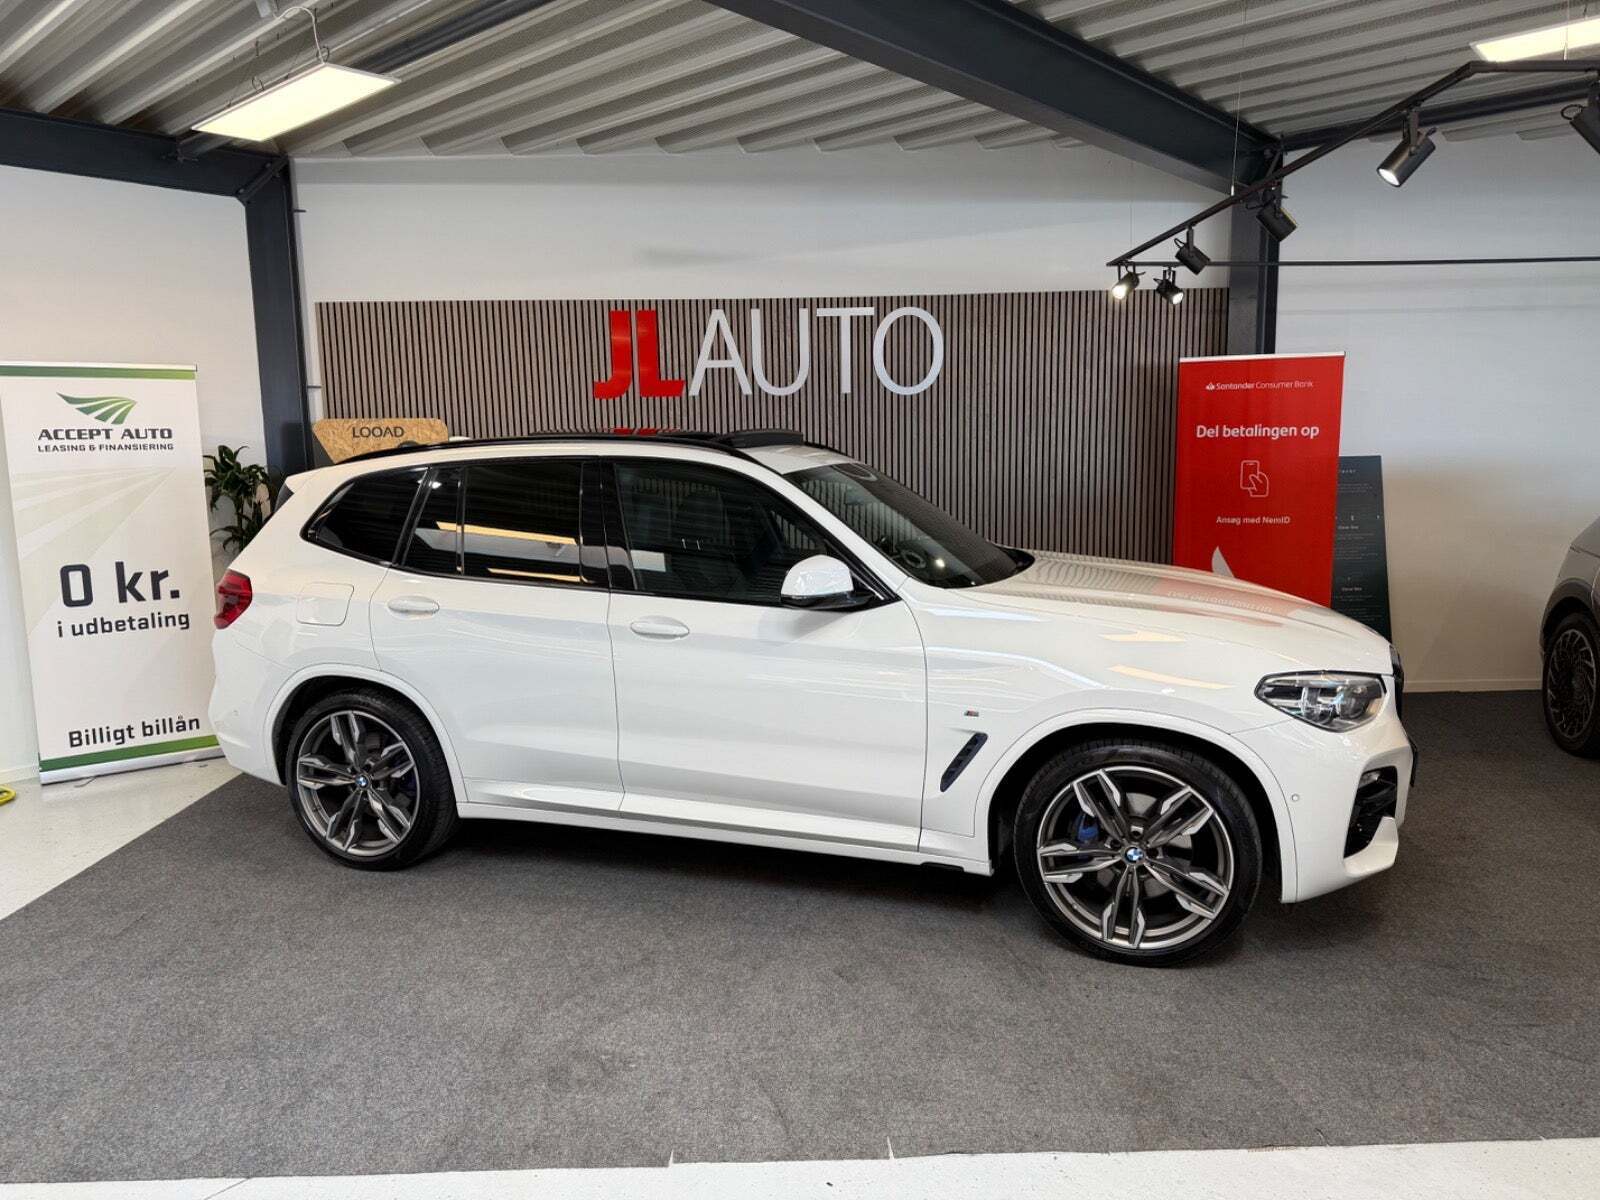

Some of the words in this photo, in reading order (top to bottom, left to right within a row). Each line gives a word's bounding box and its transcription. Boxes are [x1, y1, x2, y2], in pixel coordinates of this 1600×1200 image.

[1216, 381, 1255, 391] Santander
[1255, 380, 1293, 390] Consumer
[1294, 380, 1313, 388] Bank
[38, 428, 113, 441] ACCEPT
[121, 428, 173, 440] AUTO
[351, 426, 405, 439] LOOAD
[1196, 424, 1219, 439] Del
[1222, 423, 1298, 441] betalingen
[1300, 425, 1320, 440] op
[38, 444, 86, 453] LEASING
[89, 443, 96, 451] &
[98, 442, 174, 452] FINANSIERING
[1242, 515, 1261, 525] med
[1262, 515, 1291, 524] NemID
[60, 563, 94, 608] 0
[115, 561, 180, 604] kr.
[57, 621, 64, 638] i
[71, 611, 191, 637] udbetaling
[68, 723, 136, 748] Billigt
[141, 714, 201, 738] billån
